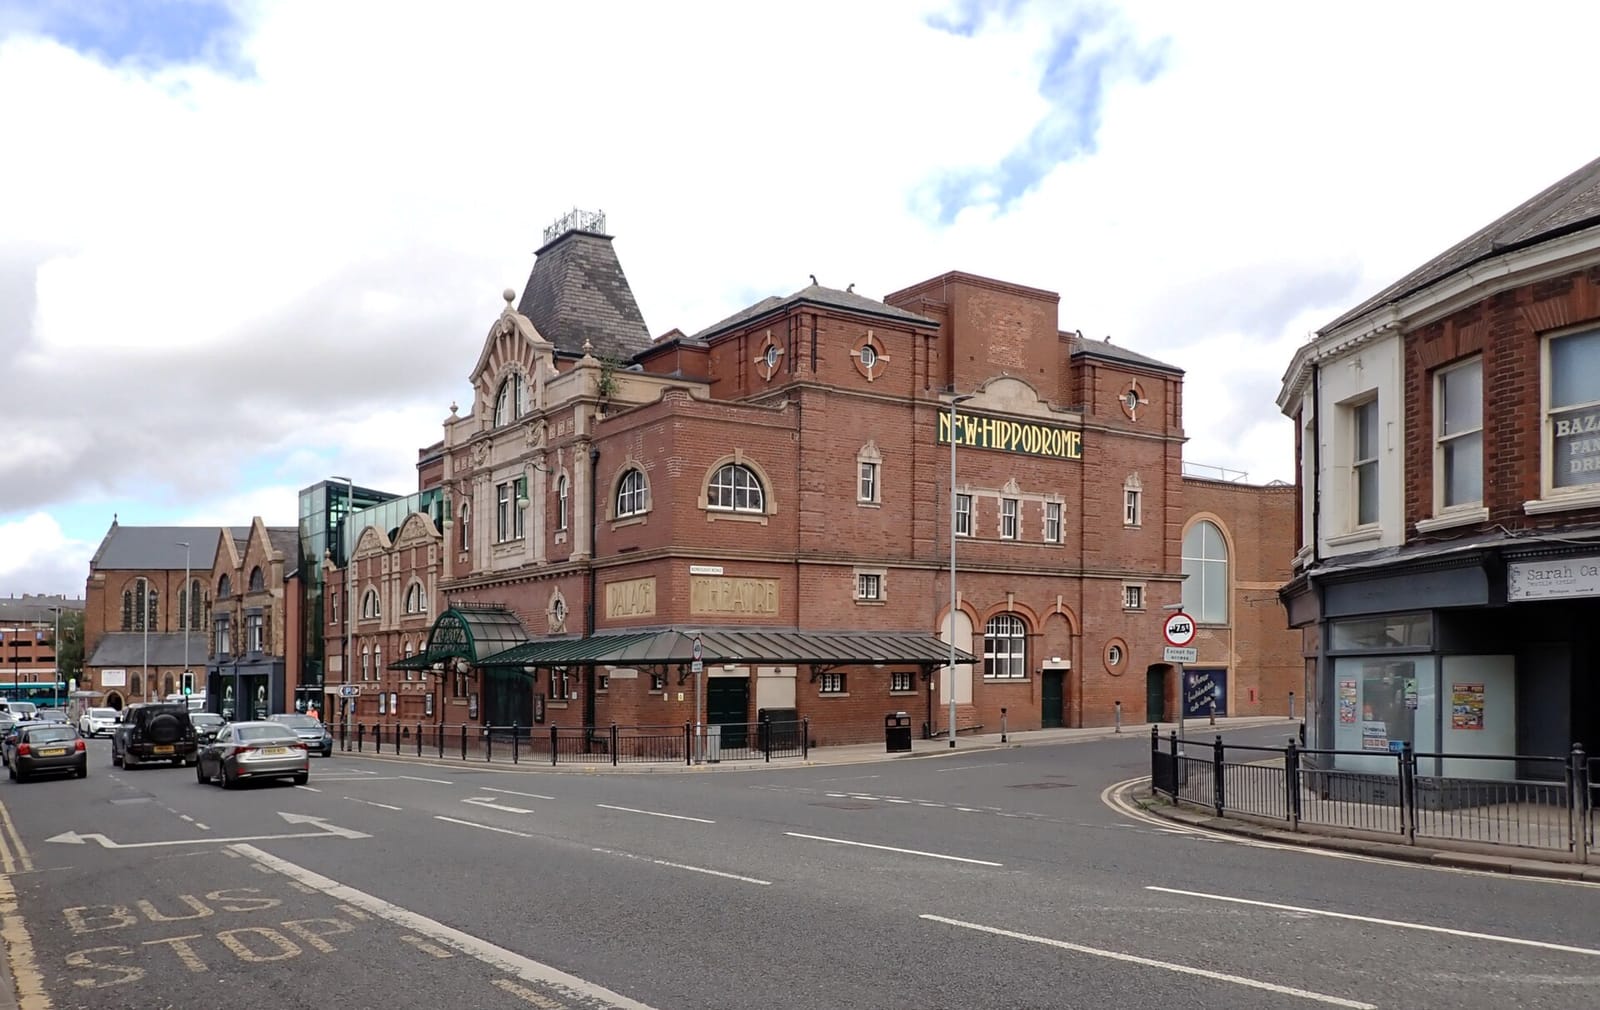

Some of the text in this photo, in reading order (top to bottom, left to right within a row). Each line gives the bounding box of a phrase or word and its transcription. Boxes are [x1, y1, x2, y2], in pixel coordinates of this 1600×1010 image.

[1556, 415, 1600, 437] BAZ
[1527, 564, 1600, 581] Sarah Ca
[611, 578, 776, 617] PALACE THEATRE
[1190, 674, 1209, 688] Show
[63, 887, 282, 935] BUS
[63, 916, 360, 990] STOP
